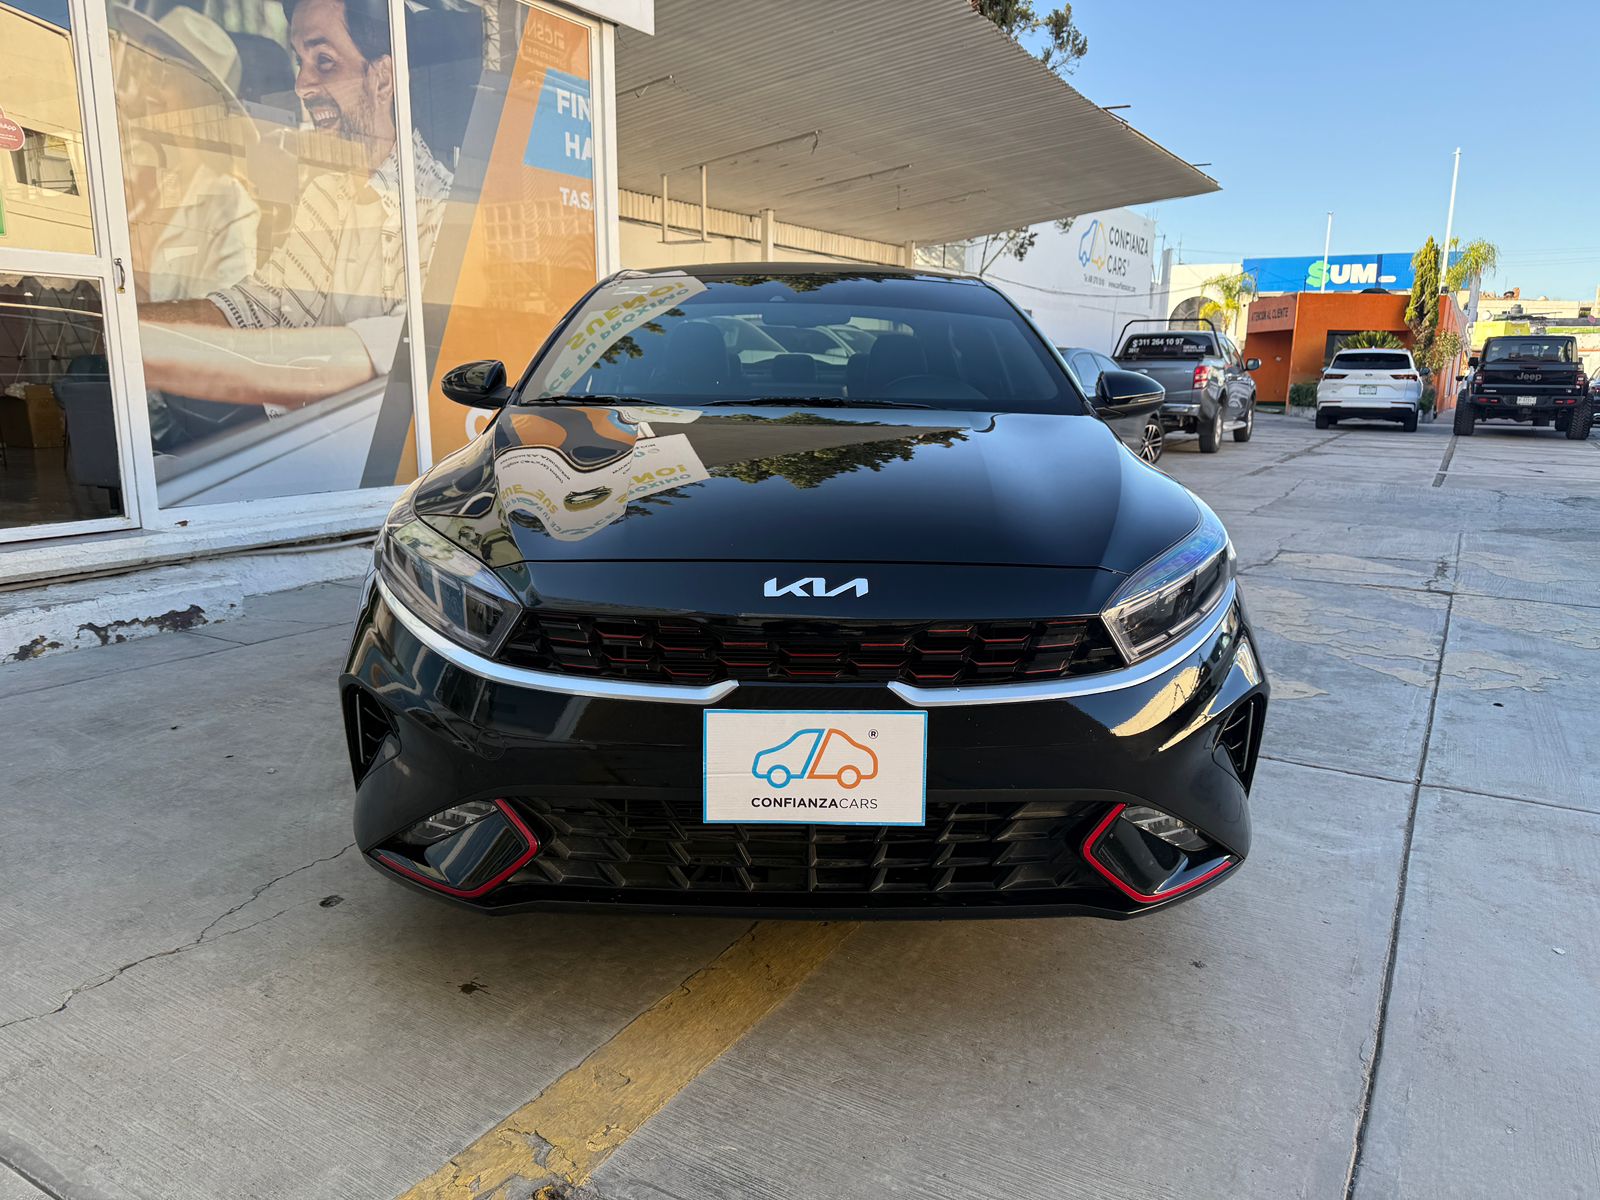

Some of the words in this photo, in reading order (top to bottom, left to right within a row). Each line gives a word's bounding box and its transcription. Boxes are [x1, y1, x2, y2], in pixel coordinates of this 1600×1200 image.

[559, 186, 594, 211] TAS
[1108, 226, 1149, 257] CONFIANZA
[1516, 372, 1542, 382] Jeep
[764, 577, 869, 598] KIA
